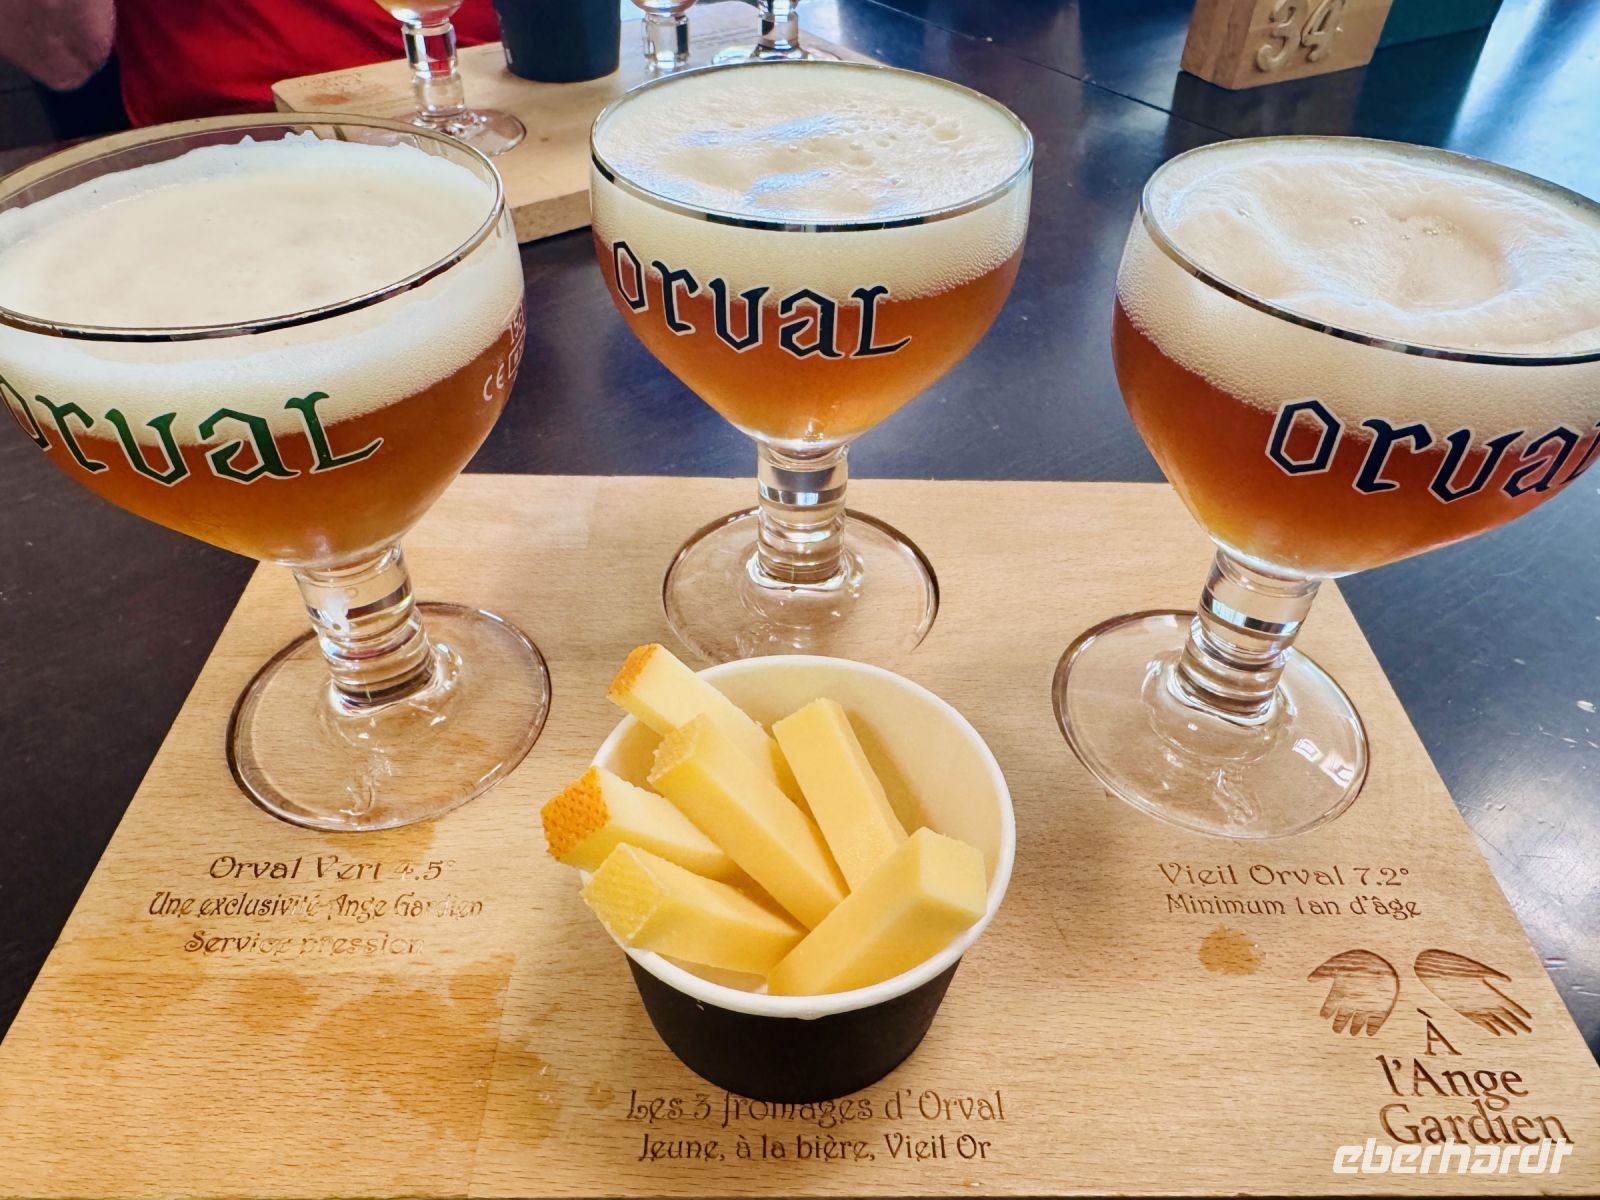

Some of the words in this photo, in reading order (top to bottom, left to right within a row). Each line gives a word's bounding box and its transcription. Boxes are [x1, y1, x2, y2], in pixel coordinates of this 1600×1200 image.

[1256, 0, 1345, 72] 34
[209, 856, 303, 880] Orval
[1158, 862, 1239, 887] Vieil
[1249, 864, 1345, 886] Orval
[149, 891, 193, 917] Une
[1166, 893, 1286, 915] Minimum
[1349, 895, 1421, 921] d'âge
[184, 930, 292, 955] Service
[1416, 1007, 1462, 1056] À
[1376, 1054, 1528, 1111] l'Ange
[626, 1089, 683, 1122] Les
[694, 1093, 711, 1120] 3
[885, 1089, 1006, 1120] d'Orval
[1379, 1098, 1574, 1145] Gardien
[638, 1133, 725, 1162] Jeune,
[736, 1135, 752, 1159] à
[761, 1133, 786, 1159] la
[796, 1134, 876, 1162] bière,
[883, 1133, 946, 1161] Vieil
[957, 1133, 991, 1159] Or
